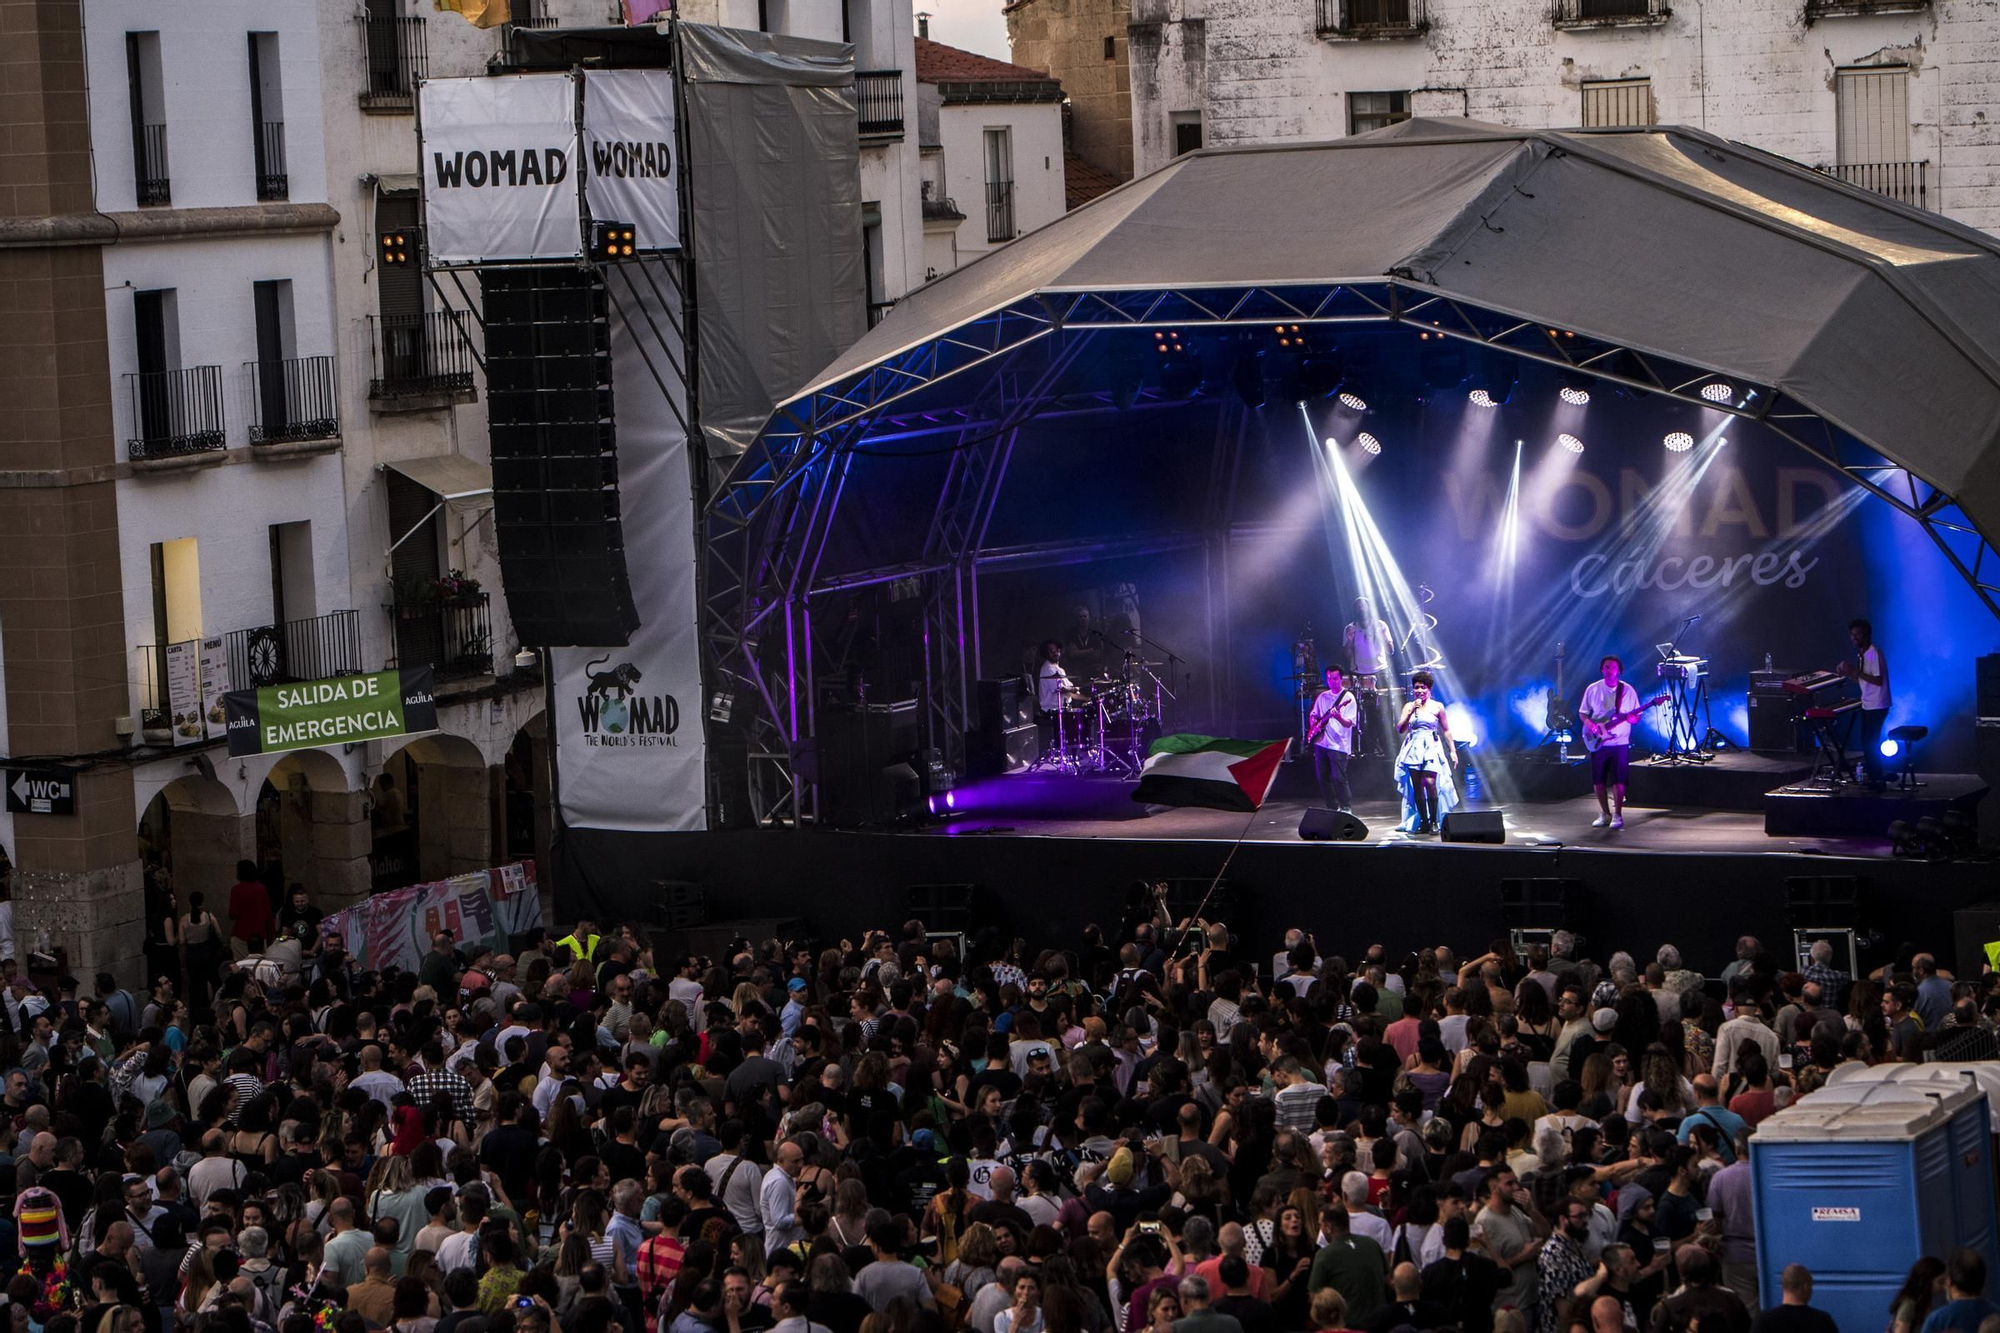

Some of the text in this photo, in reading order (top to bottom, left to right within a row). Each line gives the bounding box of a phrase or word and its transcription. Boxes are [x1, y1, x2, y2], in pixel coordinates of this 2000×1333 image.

[434, 148, 567, 188] WOMAD
[592, 141, 671, 178] WOMAD
[1441, 467, 1841, 541] WOMAD
[1571, 545, 1820, 599] Cáceres
[167, 645, 183, 654] CARTA
[204, 637, 222, 650] MENÚ
[277, 677, 379, 708] SALIDA DE
[266, 709, 399, 744] EMERGENCIA
[584, 734, 679, 747] THE WORLD'S FESTIVAL
[31, 780, 60, 799] WC
